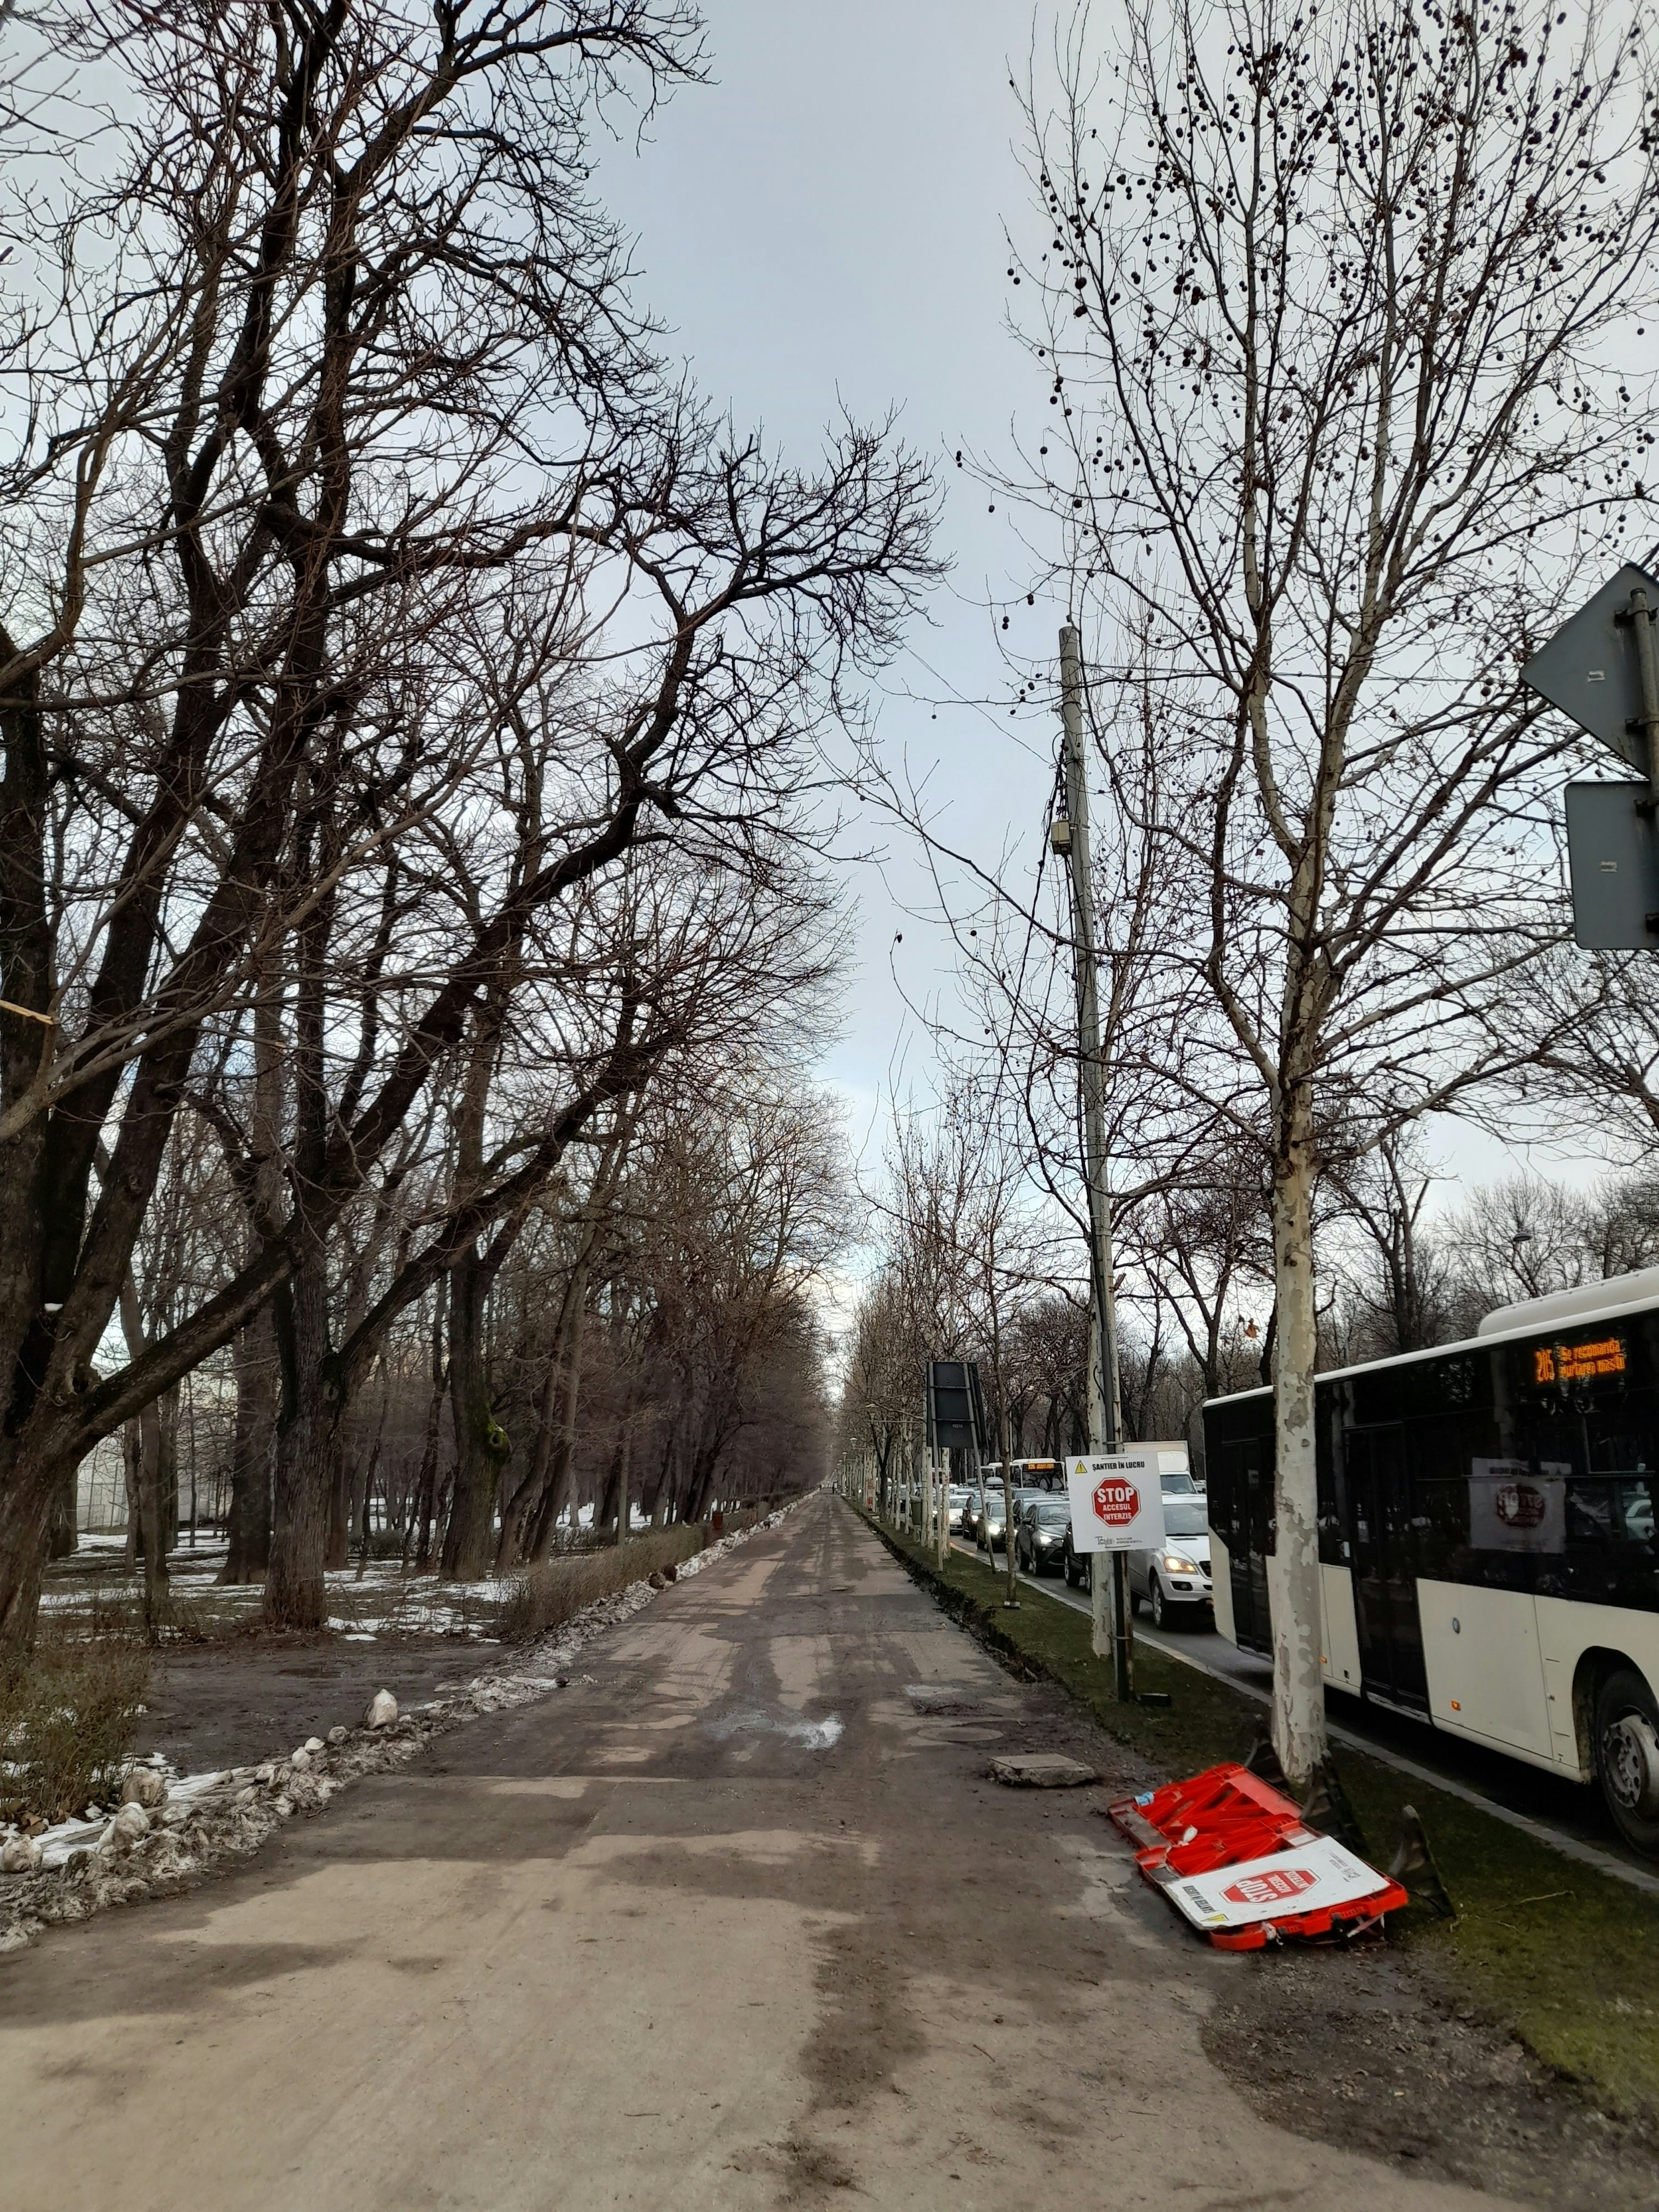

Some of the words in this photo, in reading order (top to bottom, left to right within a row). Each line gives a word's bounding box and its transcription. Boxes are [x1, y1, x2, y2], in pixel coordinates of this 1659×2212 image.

[1097, 1487, 1135, 1503] STOP
[1236, 1880, 1278, 1902] STOP
[1267, 1875, 1294, 1893] ACCESUL
